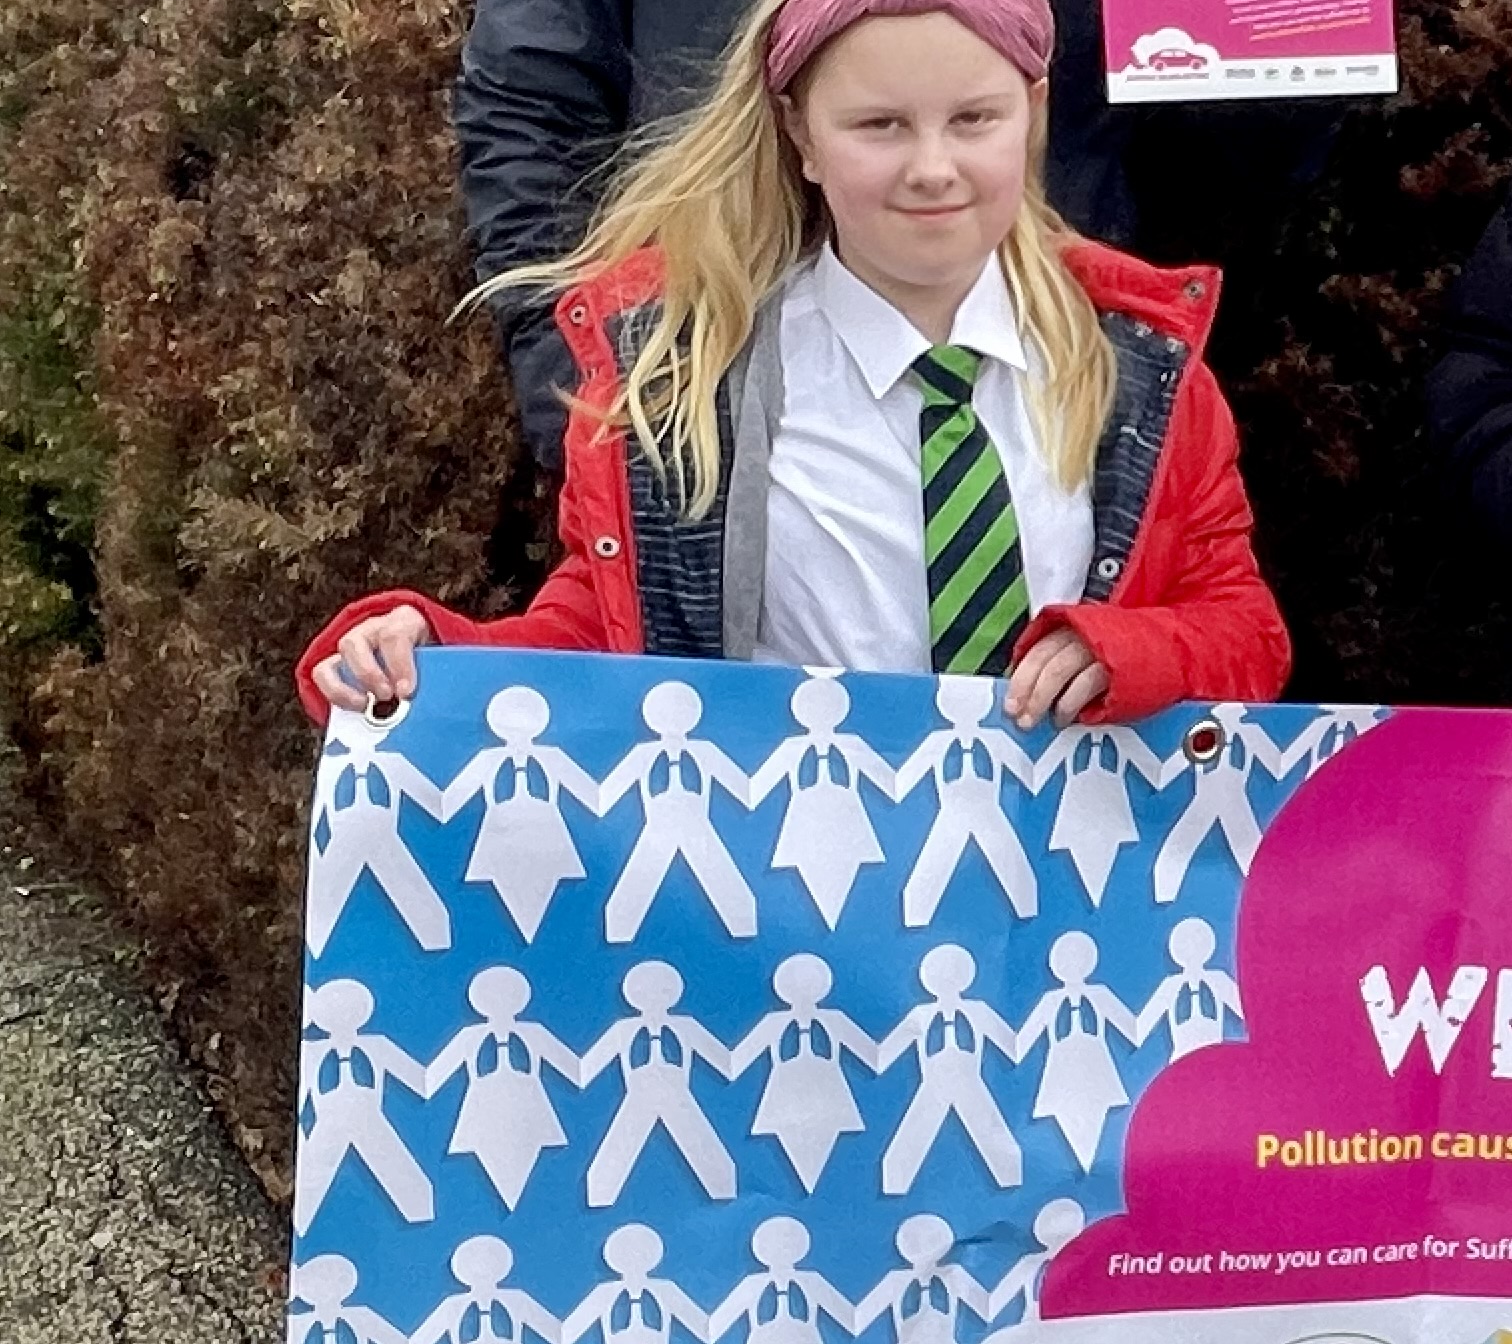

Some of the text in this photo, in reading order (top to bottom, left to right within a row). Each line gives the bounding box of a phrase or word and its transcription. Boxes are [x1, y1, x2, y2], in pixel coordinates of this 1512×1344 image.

[1257, 1129, 1423, 1168] Pollution
[1108, 1252, 1163, 1276] Find
[1168, 1254, 1212, 1274] out
[1218, 1250, 1273, 1272] how
[1274, 1249, 1322, 1274] you
[1326, 1245, 1367, 1265] can
[1372, 1241, 1418, 1263] care
[1422, 1234, 1459, 1258] for
